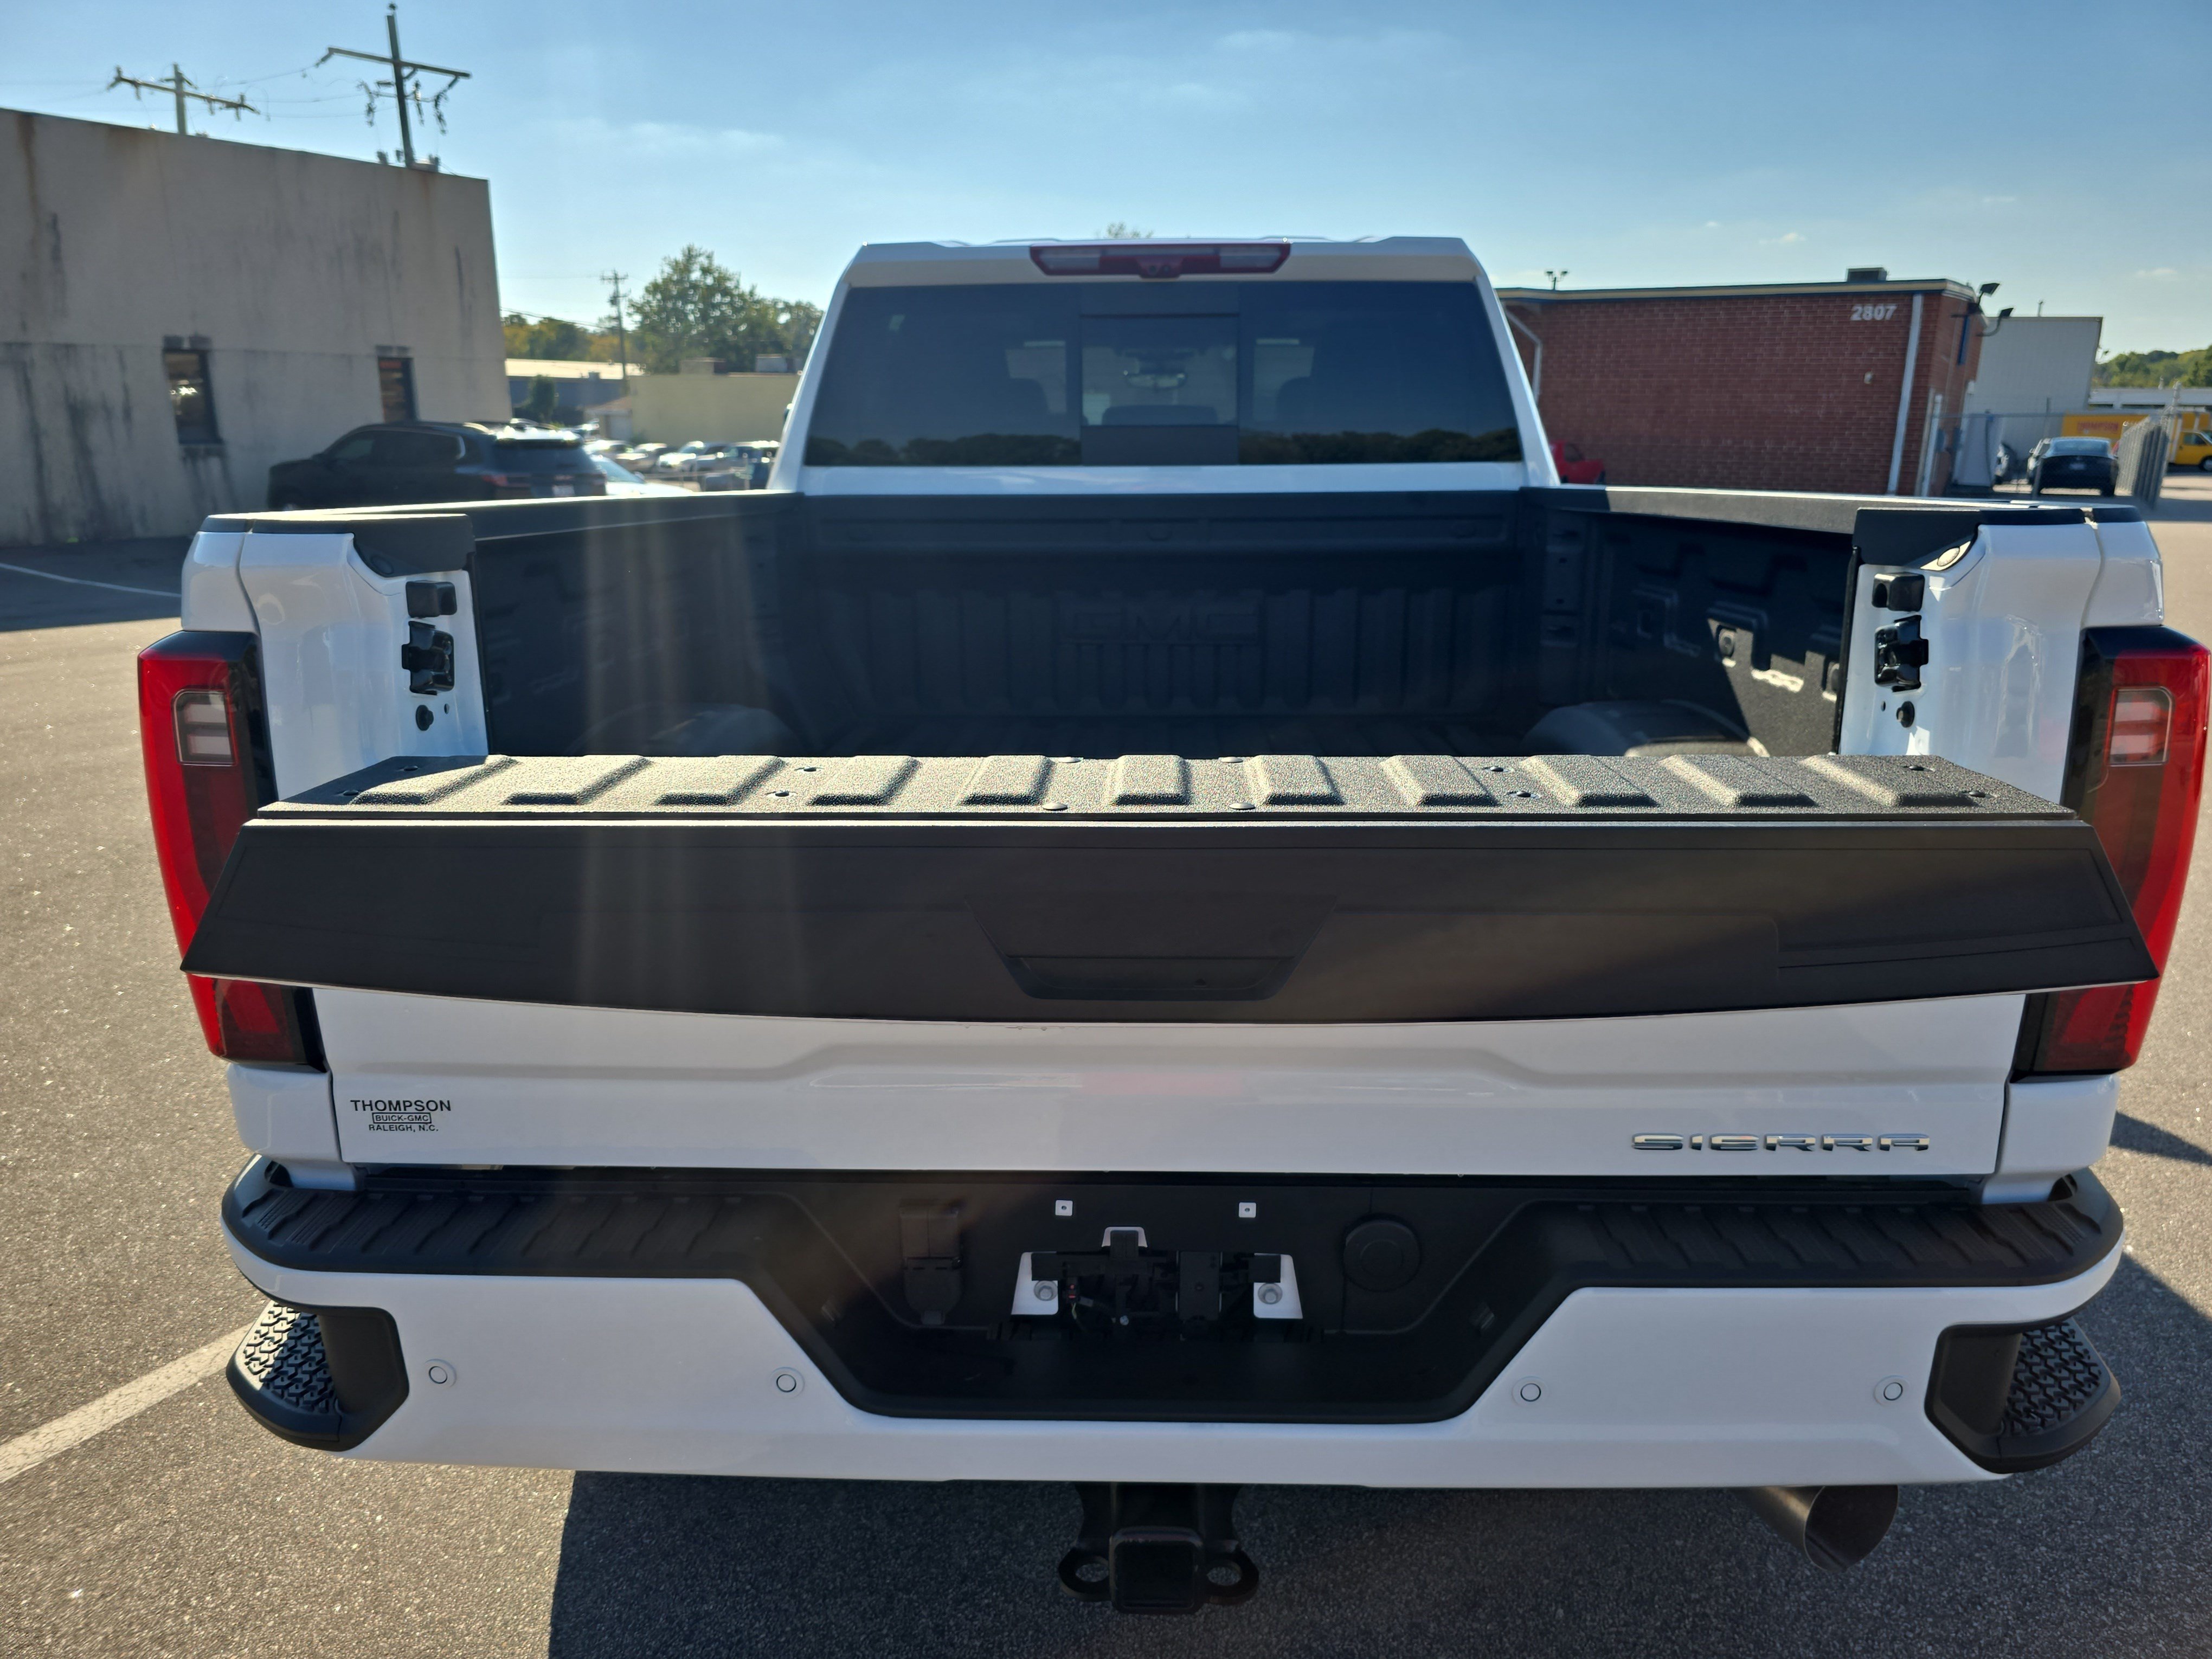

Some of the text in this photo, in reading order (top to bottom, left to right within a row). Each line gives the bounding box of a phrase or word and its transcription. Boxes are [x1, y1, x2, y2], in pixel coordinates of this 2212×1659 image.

[1850, 304, 1898, 321] 2807
[1059, 601, 1259, 640] GMC
[350, 1099, 452, 1112] THOMPSON
[369, 1124, 439, 1133] RALEIGH, N.C.
[1631, 1132, 1930, 1152] SIERRA
